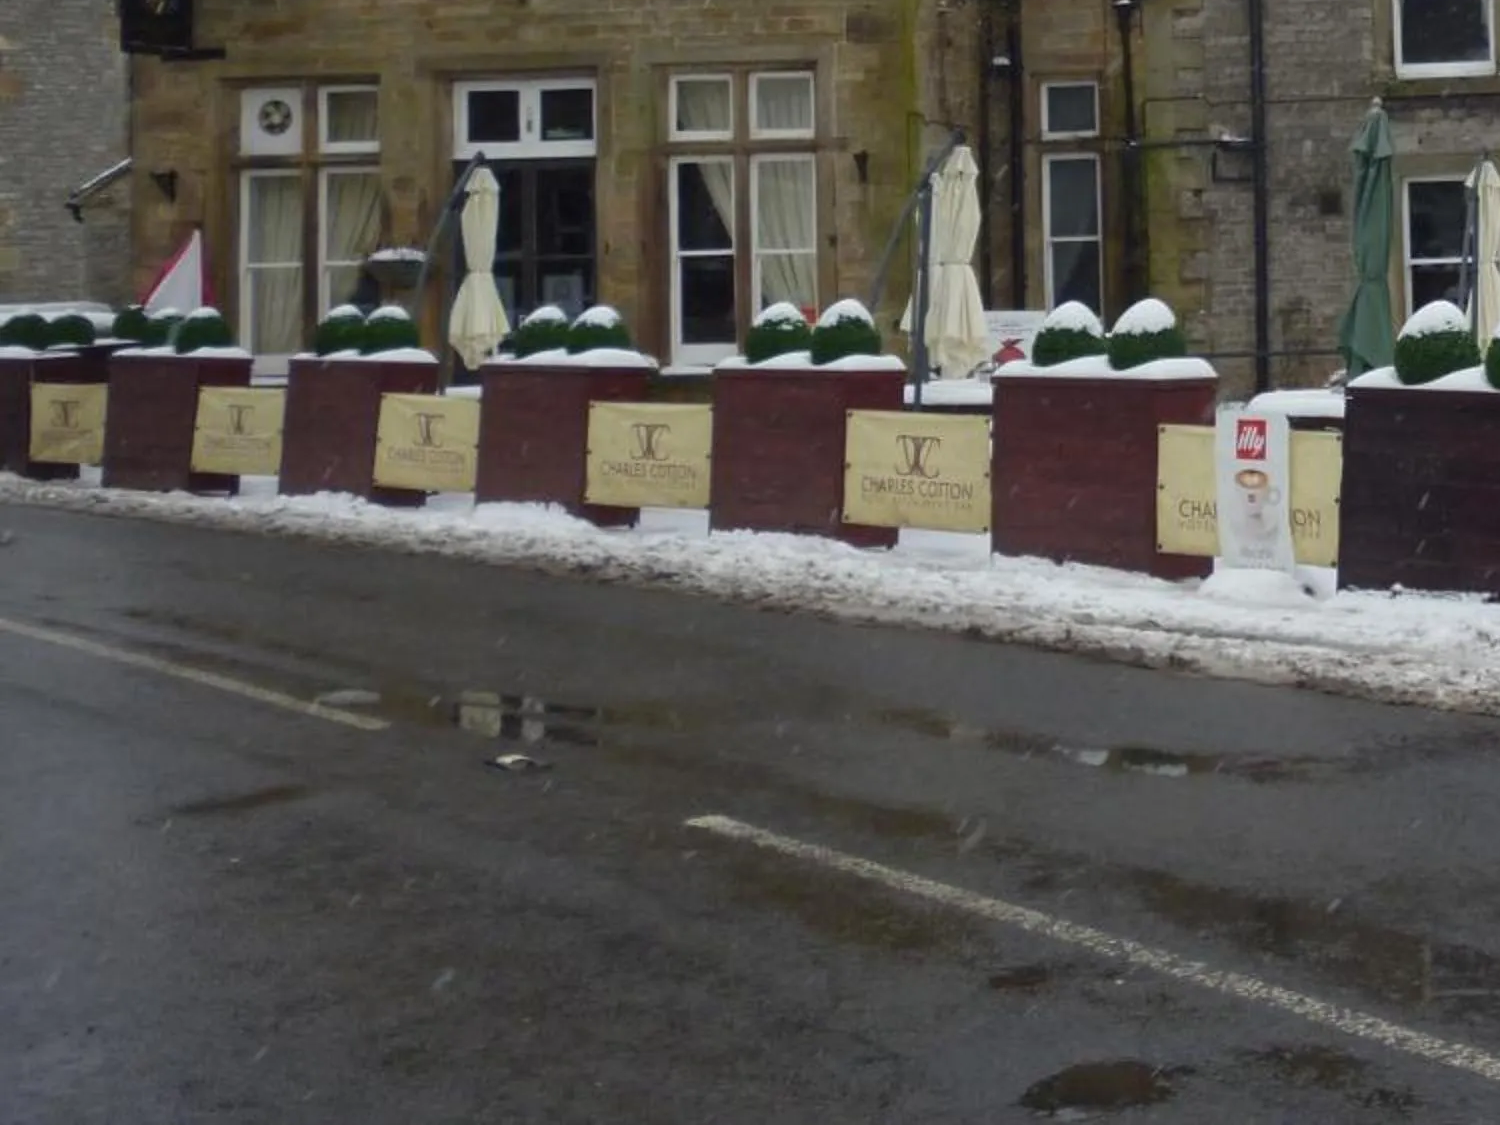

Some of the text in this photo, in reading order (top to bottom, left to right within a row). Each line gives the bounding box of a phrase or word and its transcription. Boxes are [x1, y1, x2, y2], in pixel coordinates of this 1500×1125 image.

[1237, 426, 1265, 458] illy
[861, 476, 973, 500] CHARLES COTTON
